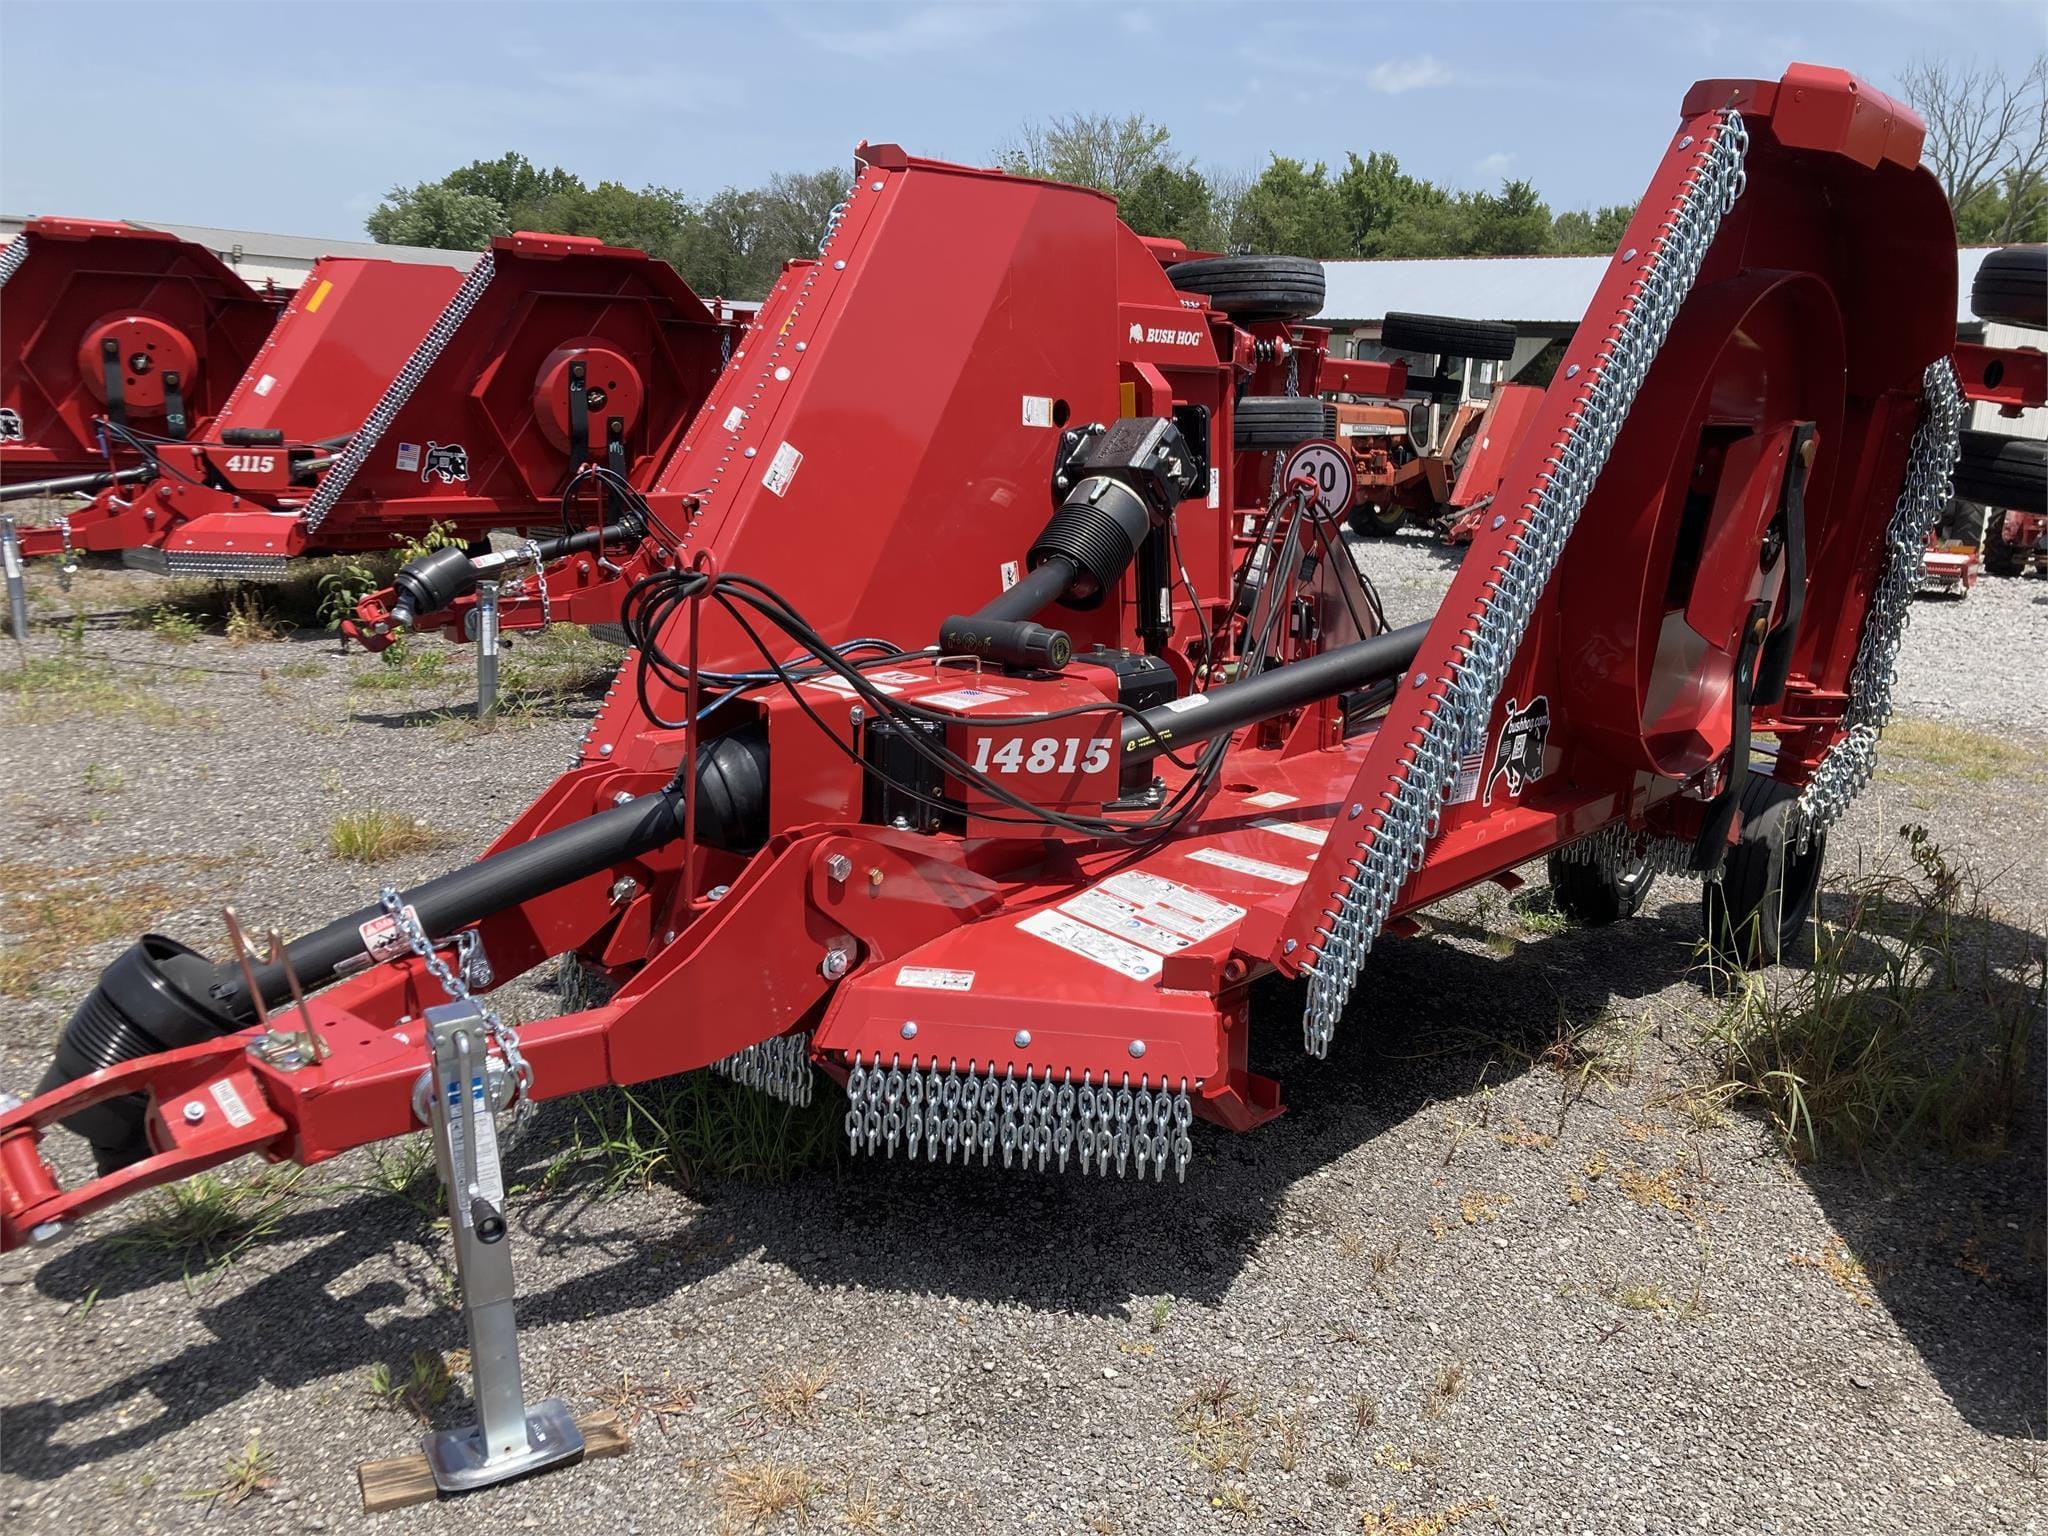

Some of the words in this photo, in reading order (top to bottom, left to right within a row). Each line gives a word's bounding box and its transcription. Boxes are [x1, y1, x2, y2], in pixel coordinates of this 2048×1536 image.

[1146, 328, 1176, 344] BUSH
[225, 455, 275, 473] 4115
[1301, 461, 1336, 493] 30
[1508, 715, 1549, 734] bushhog.com
[972, 738, 1113, 774] 14815
